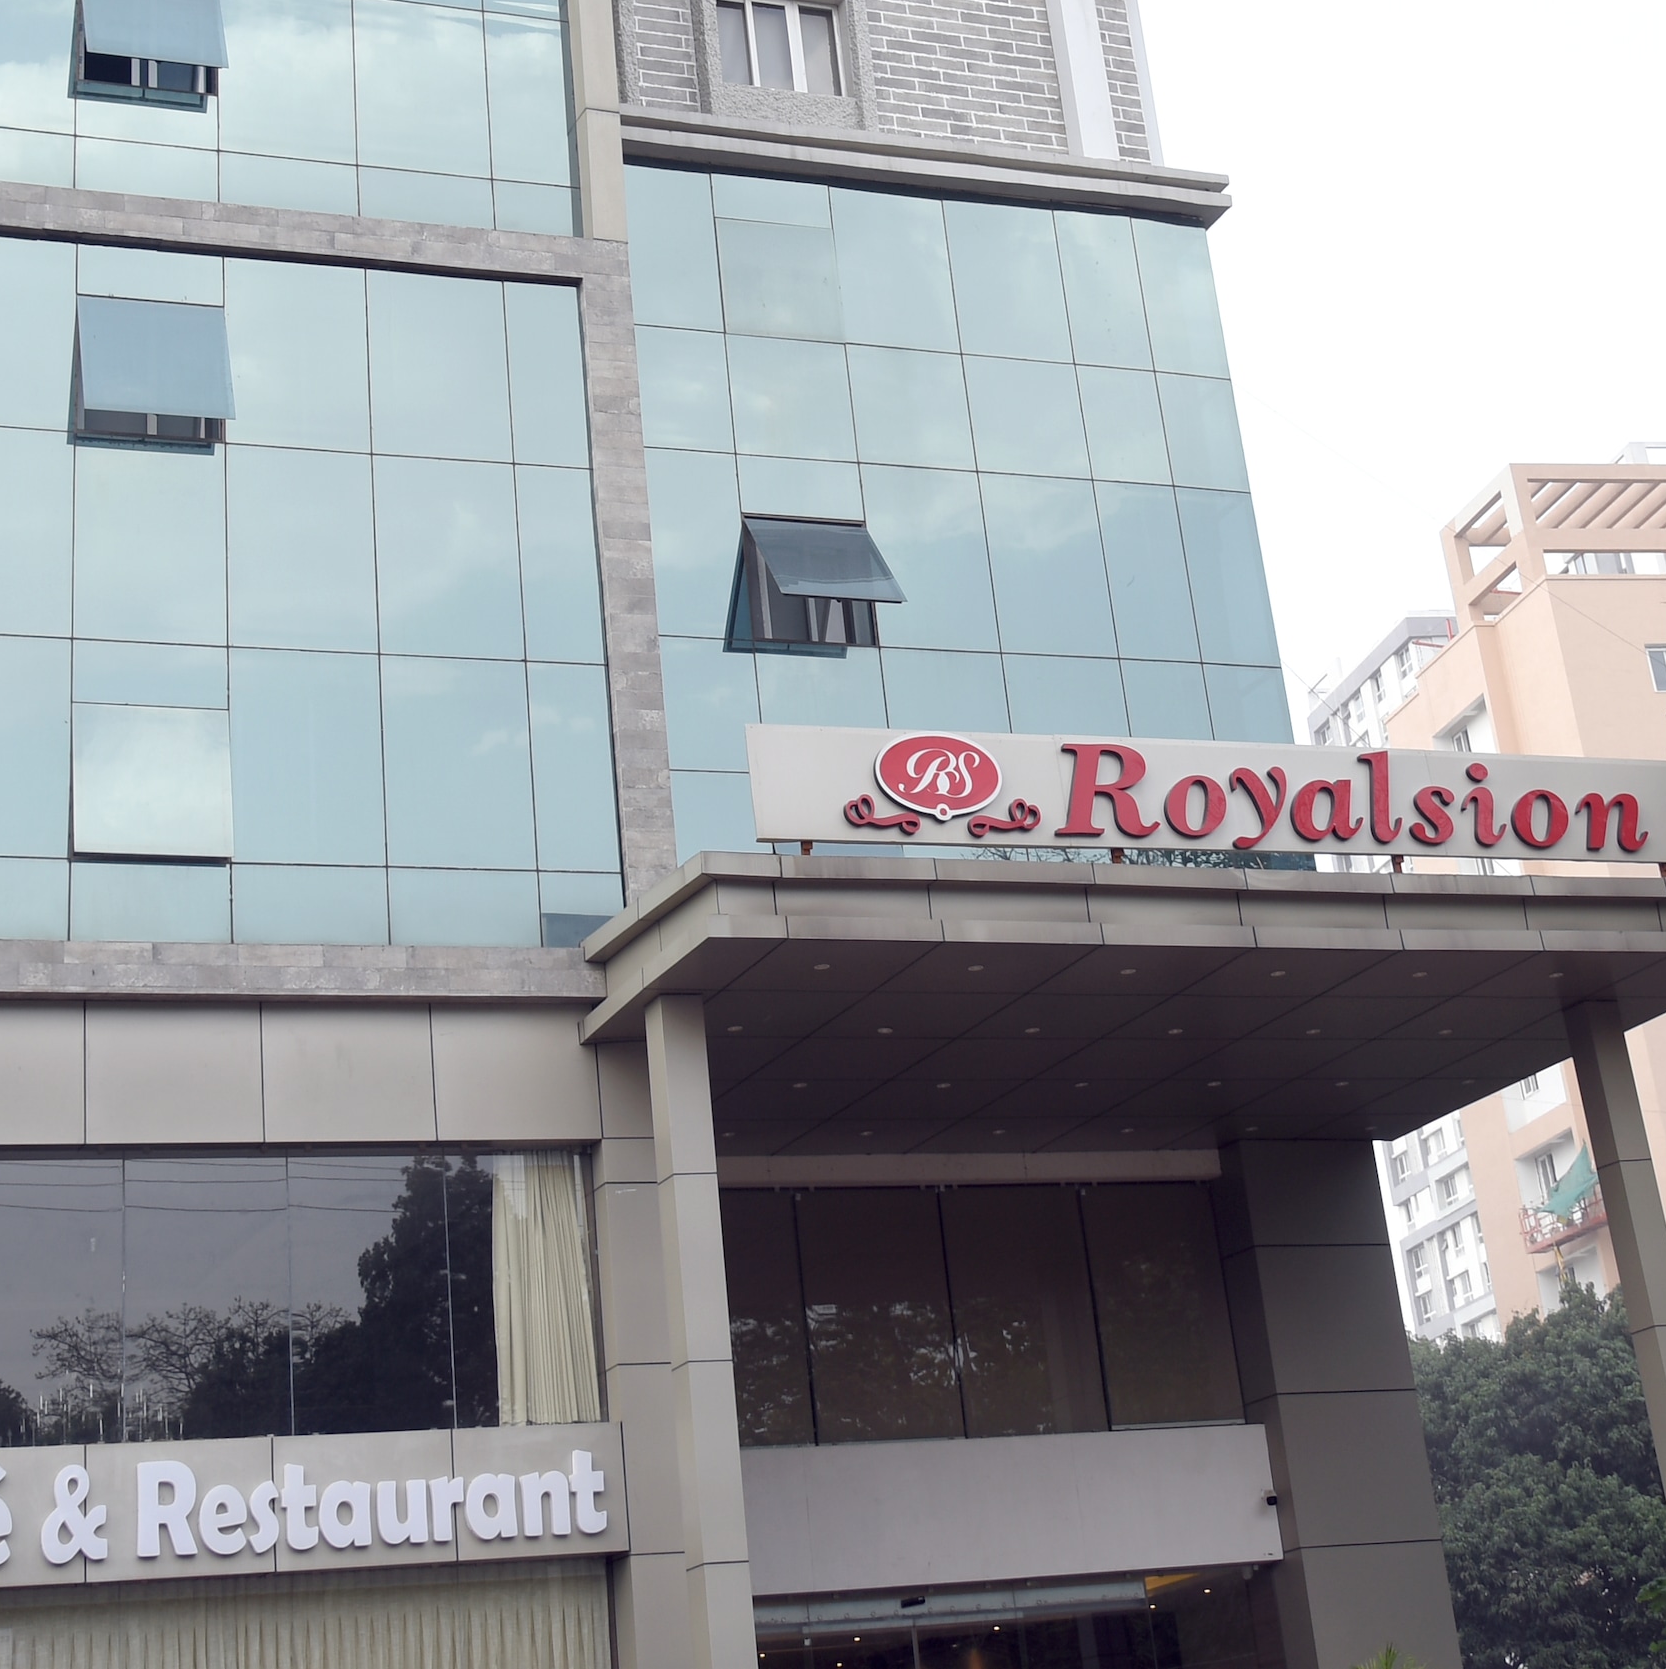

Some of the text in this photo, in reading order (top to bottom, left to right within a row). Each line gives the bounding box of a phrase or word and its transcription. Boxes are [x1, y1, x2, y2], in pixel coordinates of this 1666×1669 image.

[1054, 743, 1650, 851] Royalsion
[41, 1464, 109, 1566] &
[136, 1449, 607, 1557] Restaurant
